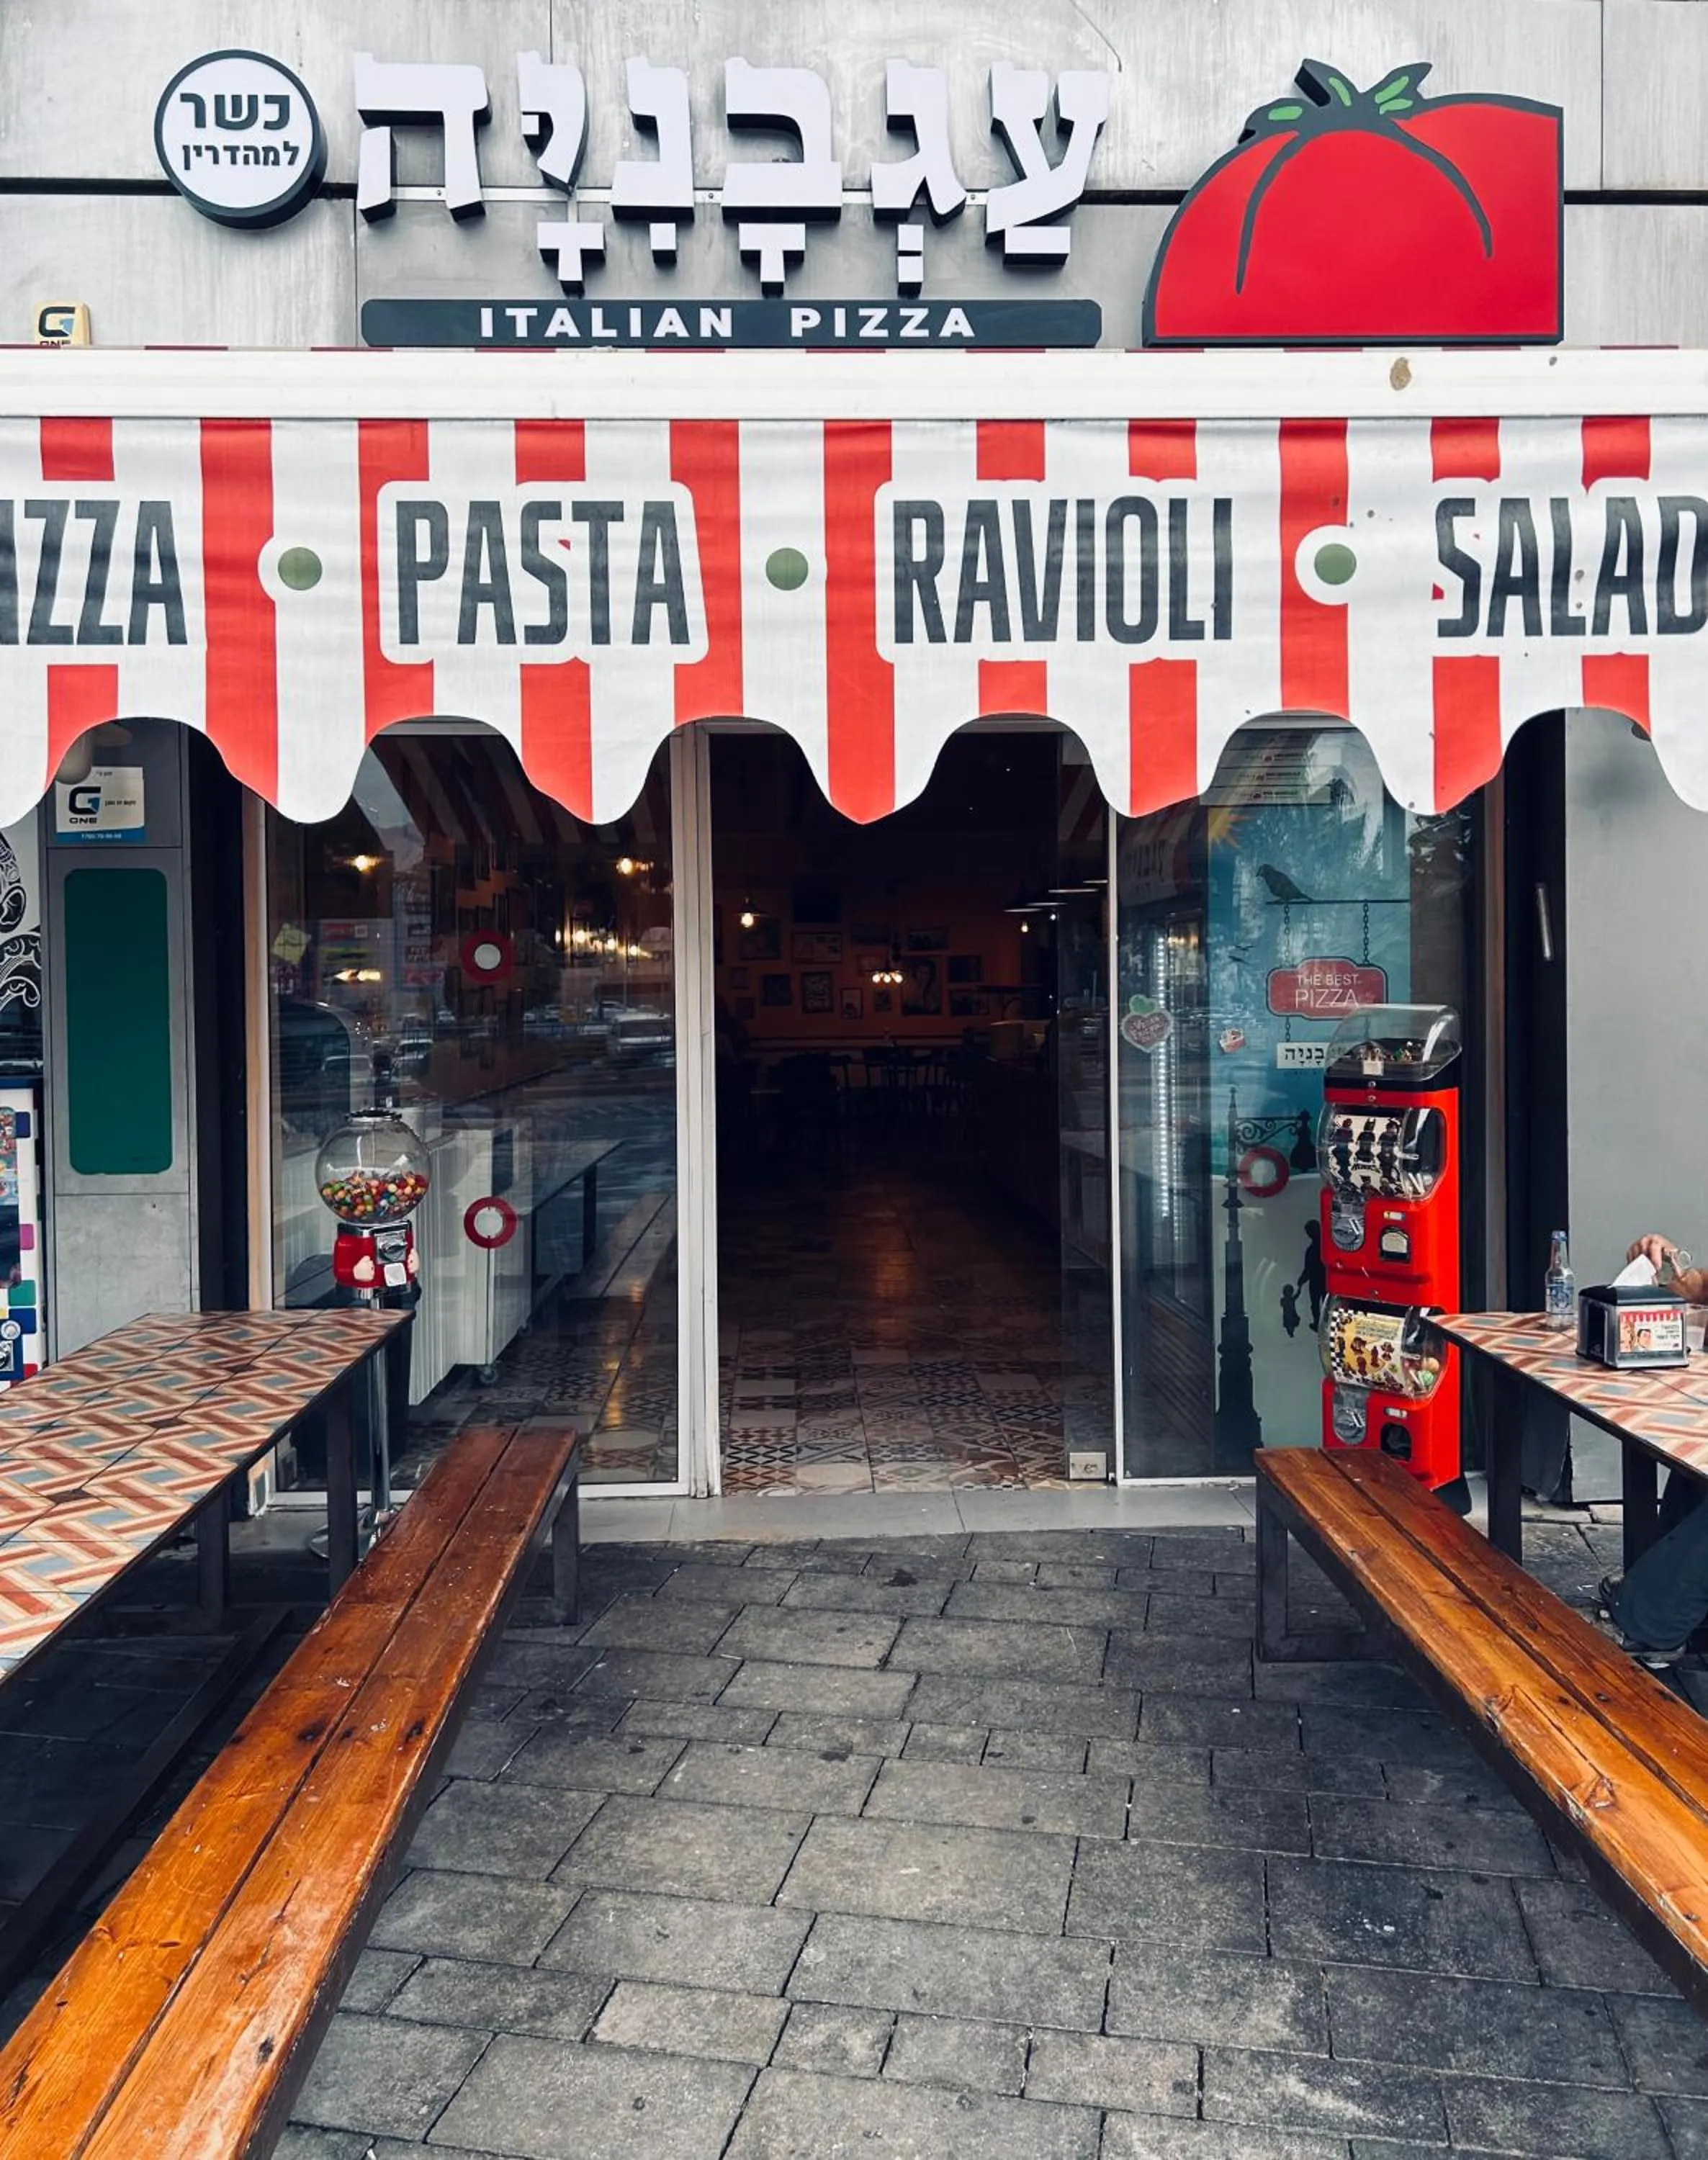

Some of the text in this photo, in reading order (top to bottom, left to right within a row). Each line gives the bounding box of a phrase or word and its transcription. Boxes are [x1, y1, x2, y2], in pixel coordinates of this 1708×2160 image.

[180, 92, 290, 131] כשר
[182, 140, 300, 171] למהדרין
[480, 307, 976, 338] ITALIAN PIZZA
[395, 500, 691, 645] PASTA
[893, 495, 1233, 644] RAVIOLI
[1434, 495, 1708, 639] SALAD
[1298, 973, 1359, 986] THE BEST
[1295, 989, 1359, 1009] PIZZA
